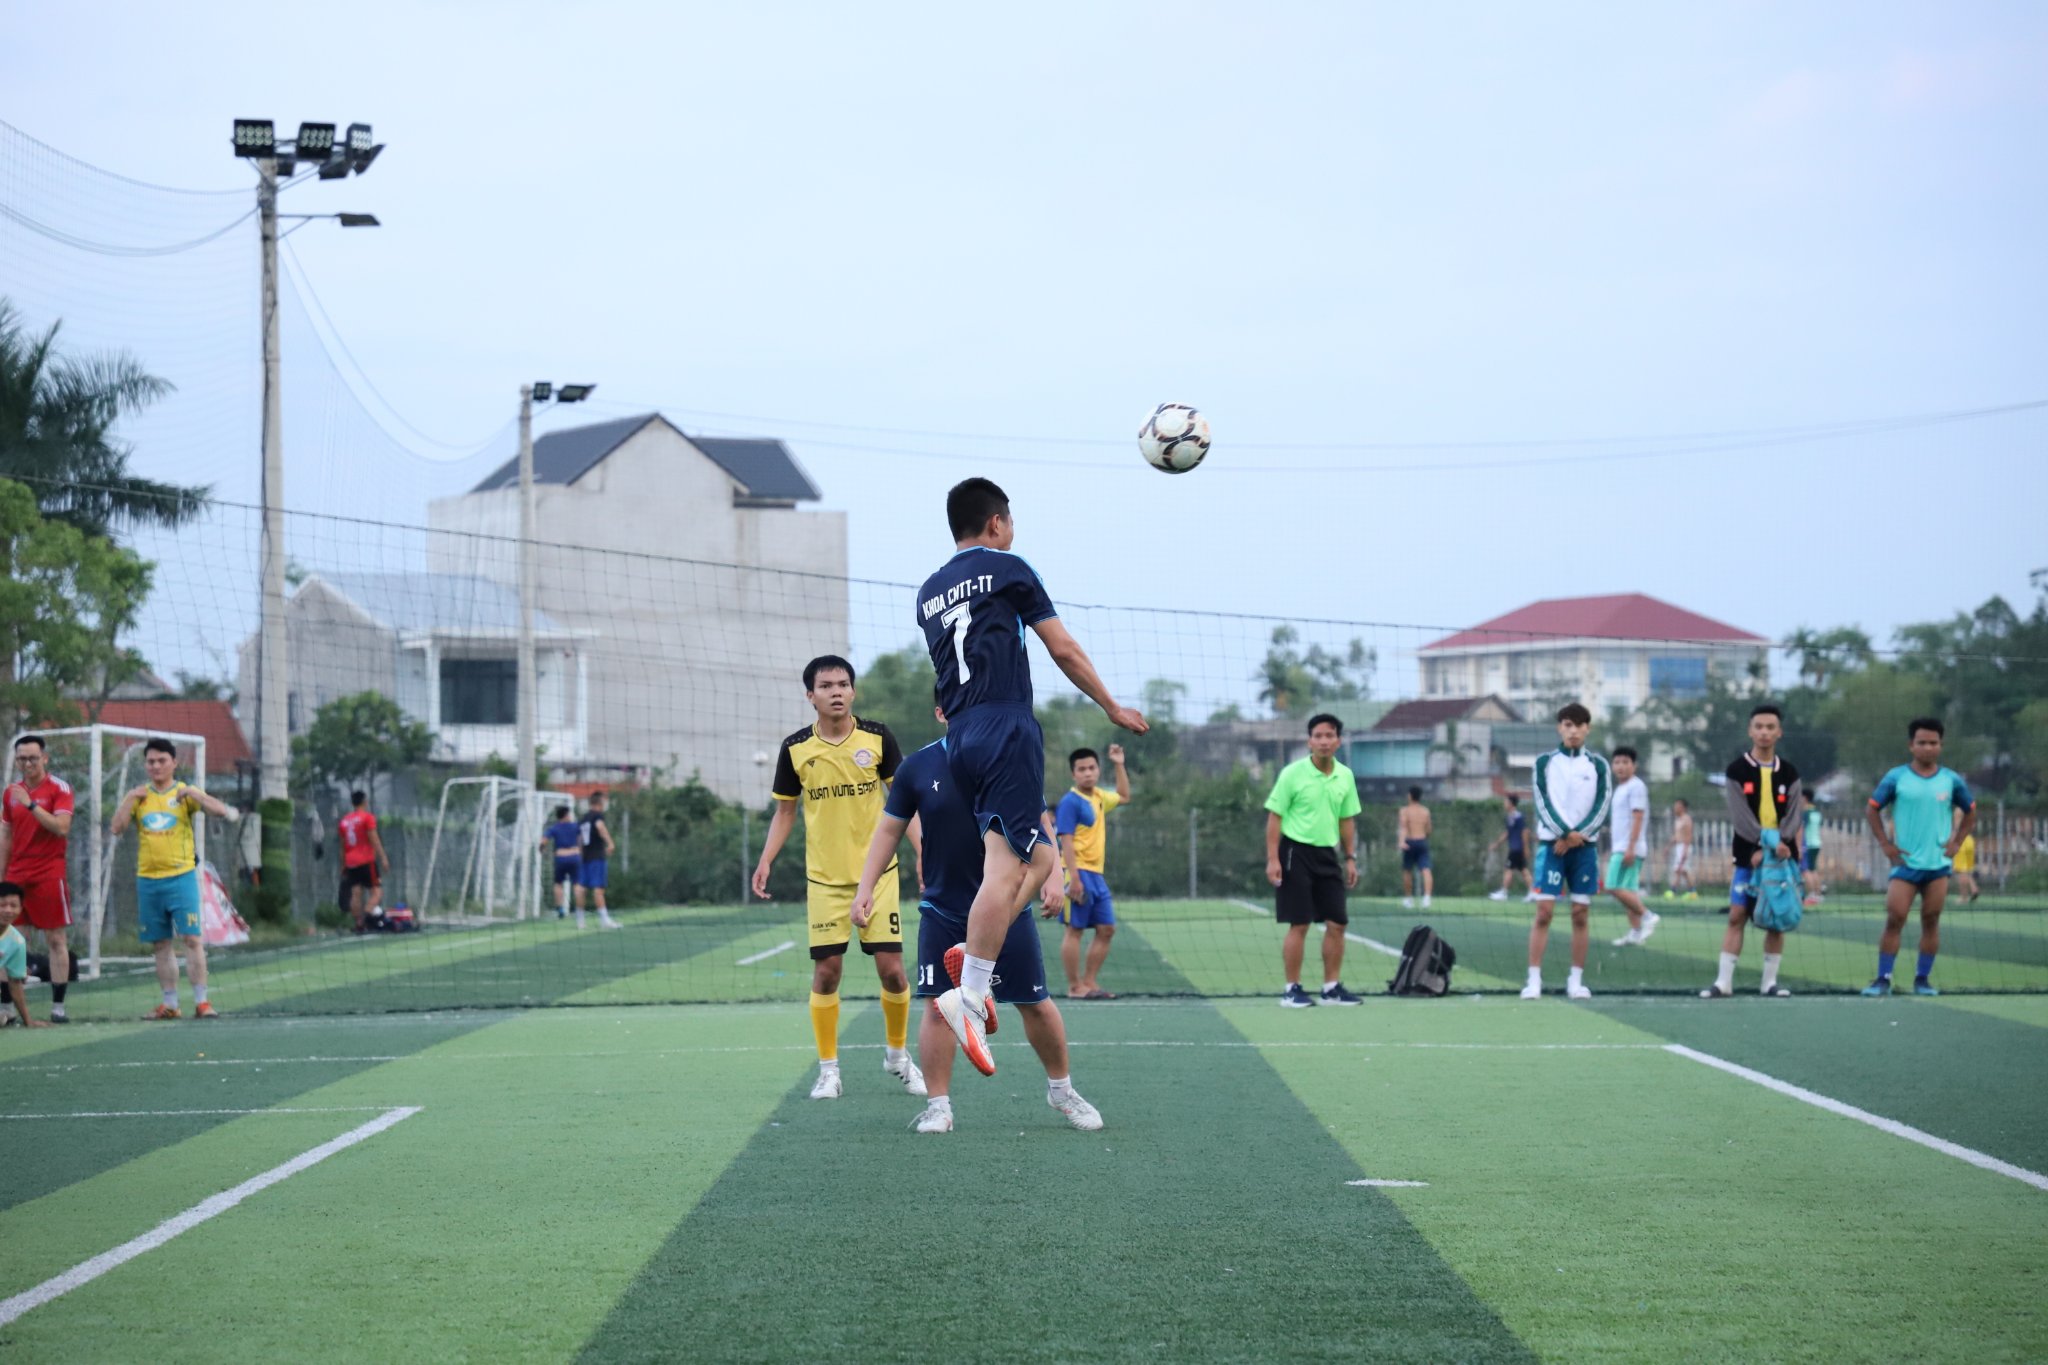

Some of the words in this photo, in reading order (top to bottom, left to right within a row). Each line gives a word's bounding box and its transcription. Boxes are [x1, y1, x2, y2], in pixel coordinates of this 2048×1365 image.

[922, 594, 946, 620] KHOA
[947, 575, 993, 606] CNTT-TT
[941, 601, 972, 685] 7
[1026, 828, 1039, 853] 7
[1547, 870, 1562, 886] 10
[889, 912, 900, 935] 9
